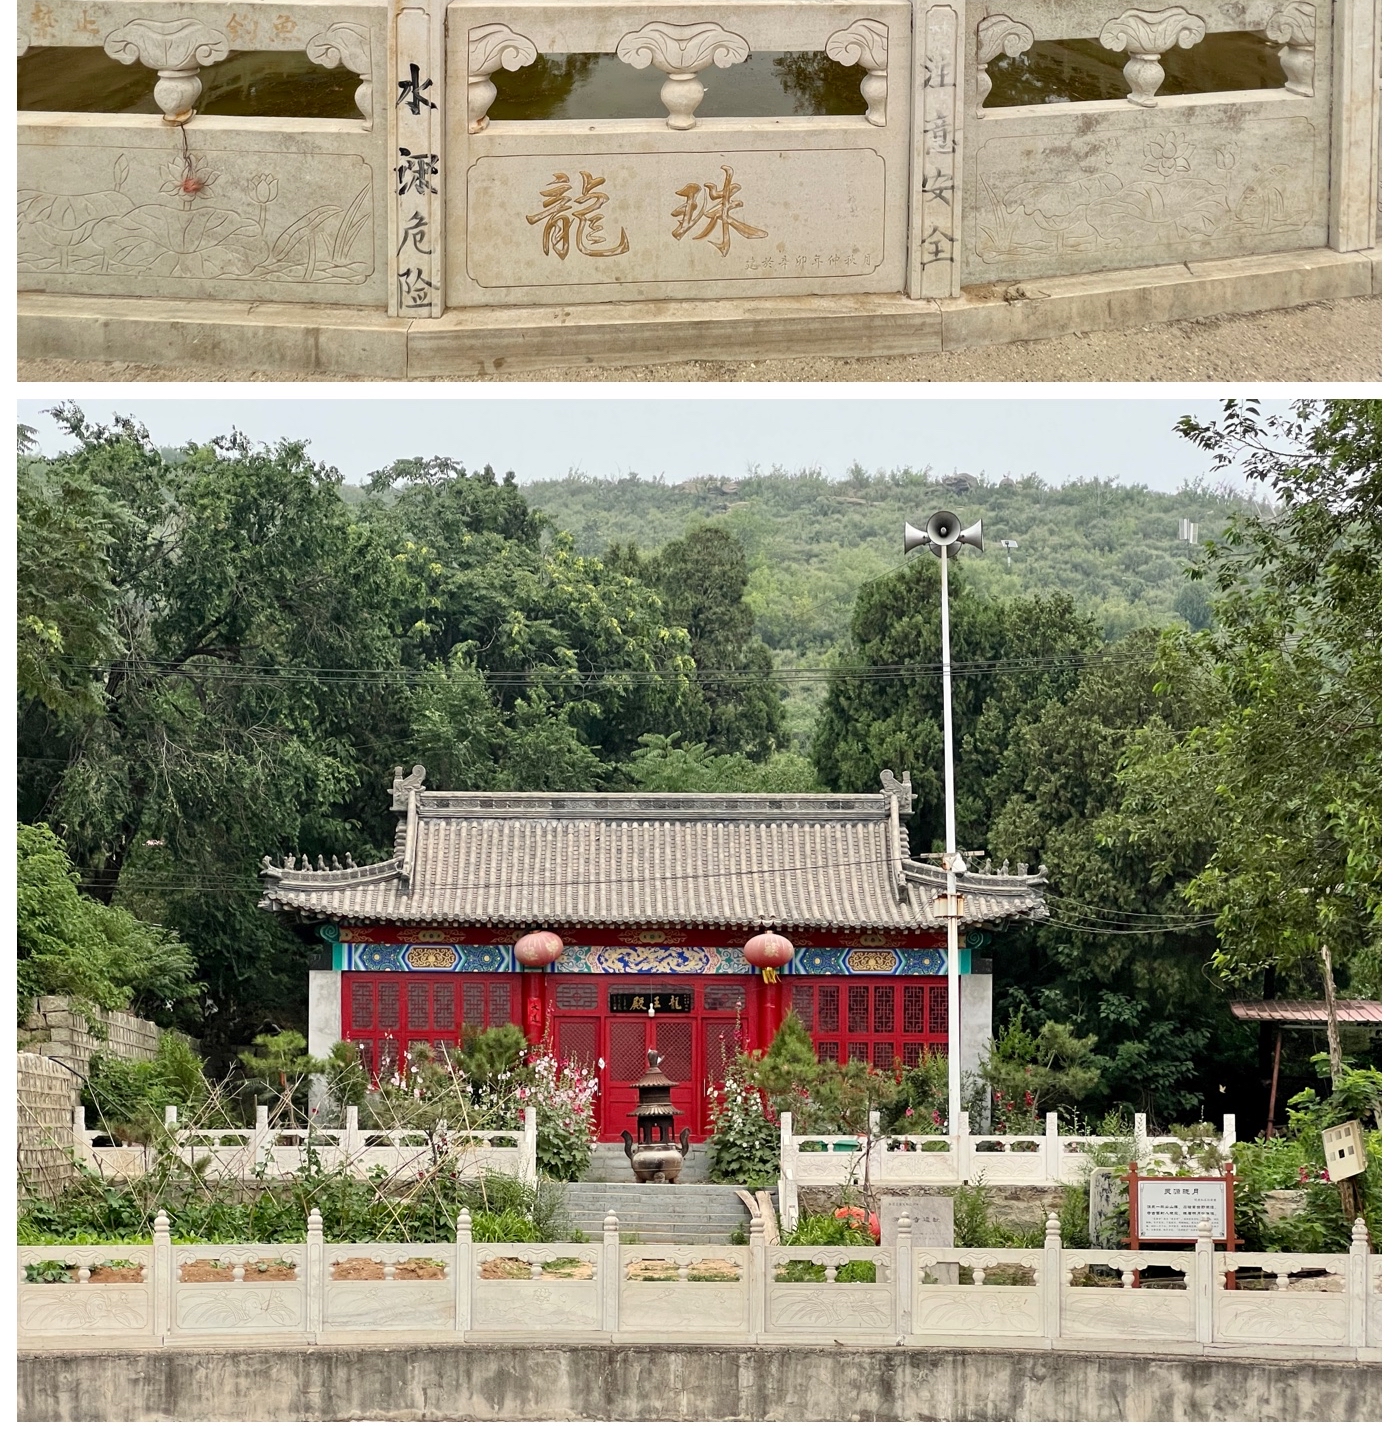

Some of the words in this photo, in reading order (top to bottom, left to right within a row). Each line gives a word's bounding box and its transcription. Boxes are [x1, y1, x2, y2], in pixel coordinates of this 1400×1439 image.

[394, 63, 439, 309] 水深危险
[525, 165, 768, 259] 龍珠
[920, 54, 957, 270] 注意安全
